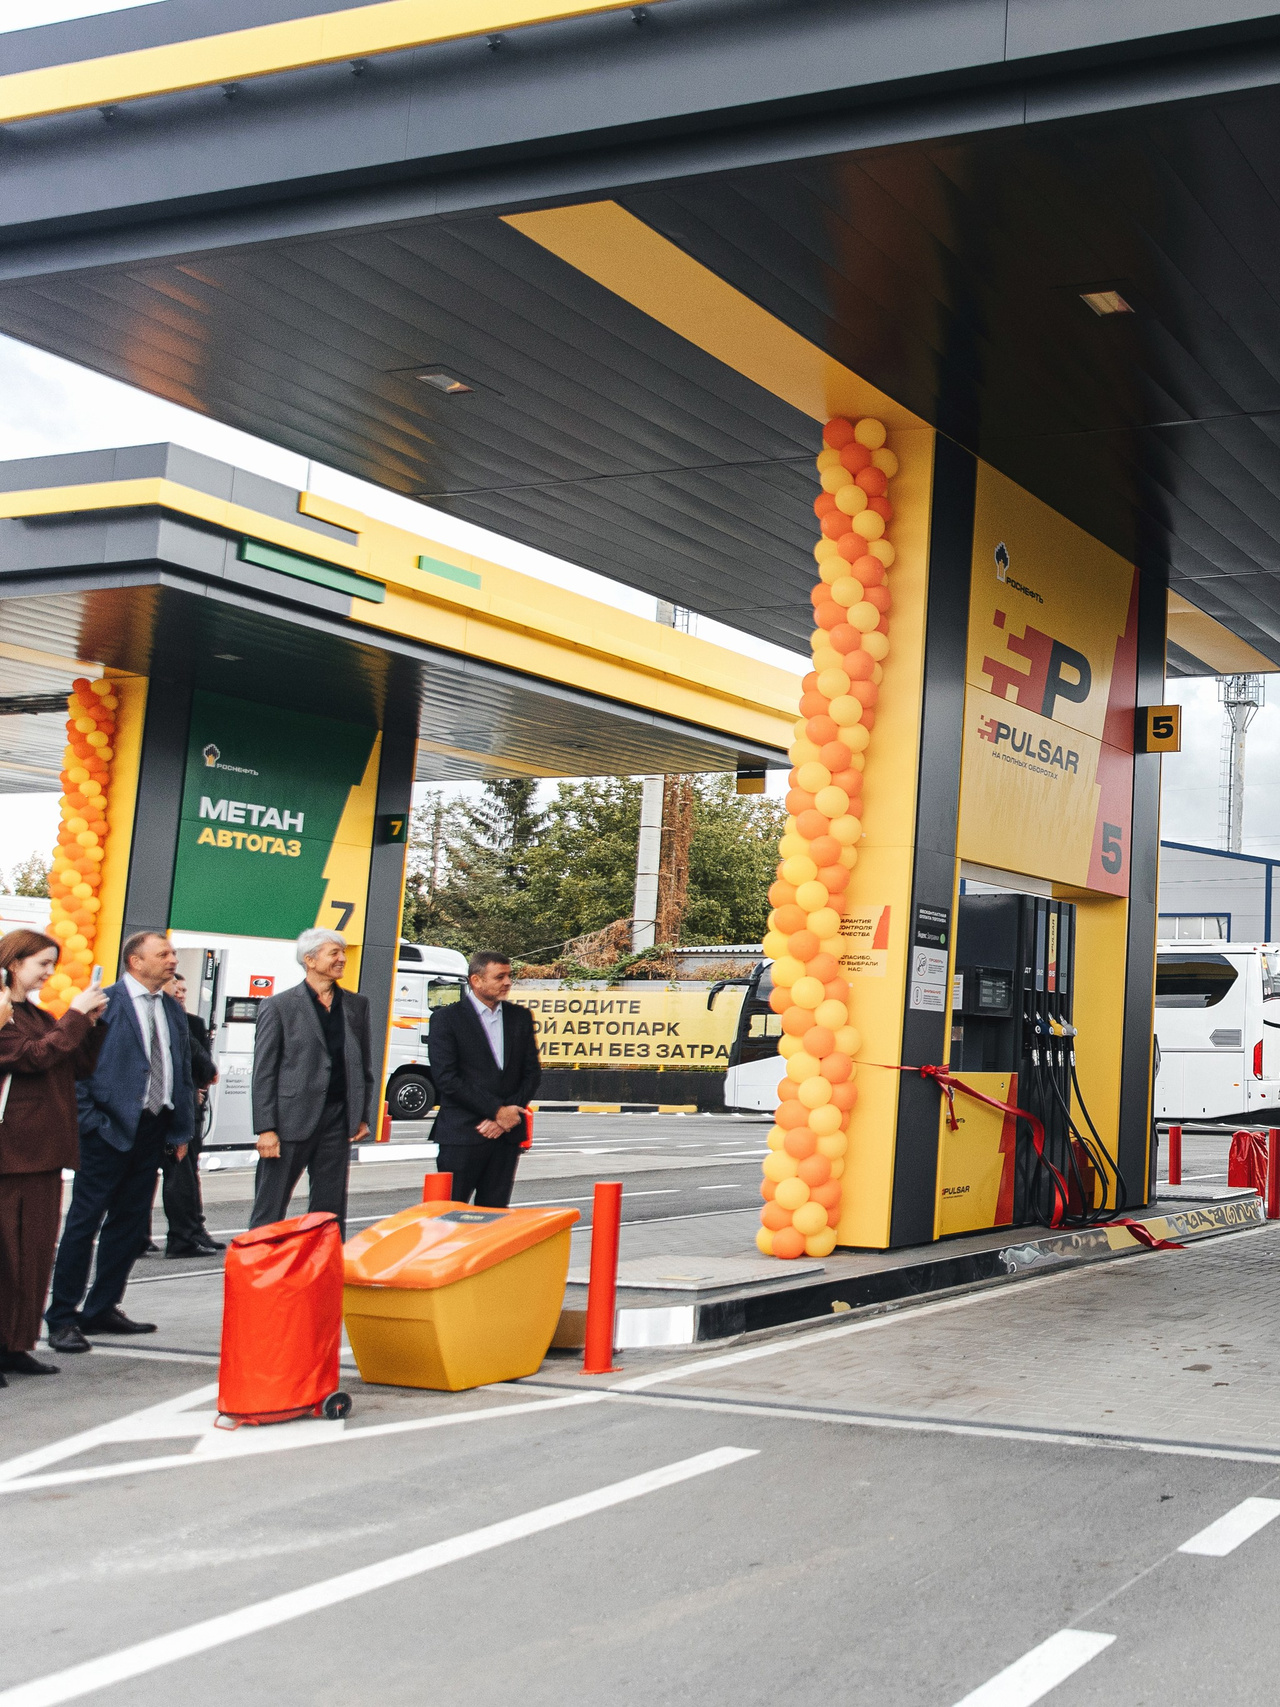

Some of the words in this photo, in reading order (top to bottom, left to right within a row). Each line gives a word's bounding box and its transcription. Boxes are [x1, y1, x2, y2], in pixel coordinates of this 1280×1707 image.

[1006, 576, 1044, 604] РОСНЕФТЬ
[1152, 715, 1174, 739] 5
[995, 721, 1080, 774] PULSAR
[216, 763, 259, 776] РОСНЕФТЬ
[992, 751, 1001, 760] НА
[1001, 754, 1028, 769] ПОЛНЫХ
[1028, 764, 1059, 780] ОБОРОТАХ
[200, 796, 305, 833] МЕТАН
[390, 820, 403, 836] 7
[197, 827, 302, 857] АВТОГАЗ
[1101, 821, 1123, 875] 5
[330, 900, 356, 931] 7
[507, 998, 641, 1015] РЕВОДИТЕ
[562, 1020, 681, 1037] АВТОПАРК
[608, 1042, 651, 1058] БЕЗ
[656, 1044, 730, 1059] ЗАТРА
[944, 1185, 970, 1195] PULSAR
